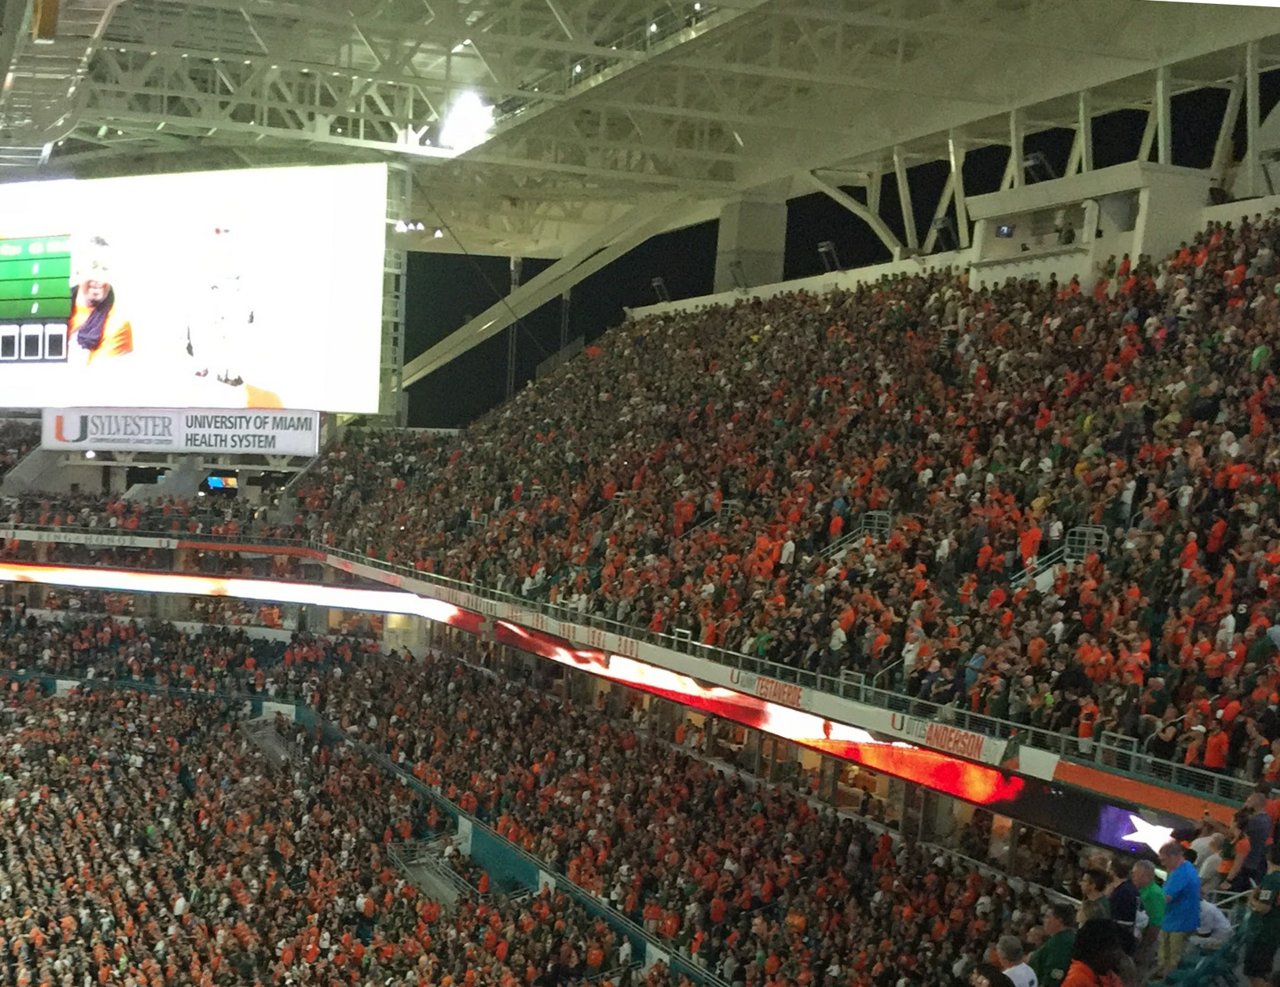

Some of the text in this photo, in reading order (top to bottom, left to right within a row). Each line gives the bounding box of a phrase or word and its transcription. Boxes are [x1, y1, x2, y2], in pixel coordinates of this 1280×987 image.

[90, 414, 173, 437] SYLVESTER
[185, 415, 313, 431] UNIVERSITY OF MIAMI
[185, 433, 229, 448] HEALTH
[231, 434, 276, 449] SYSTEM
[925, 722, 985, 760] ANDERSON
